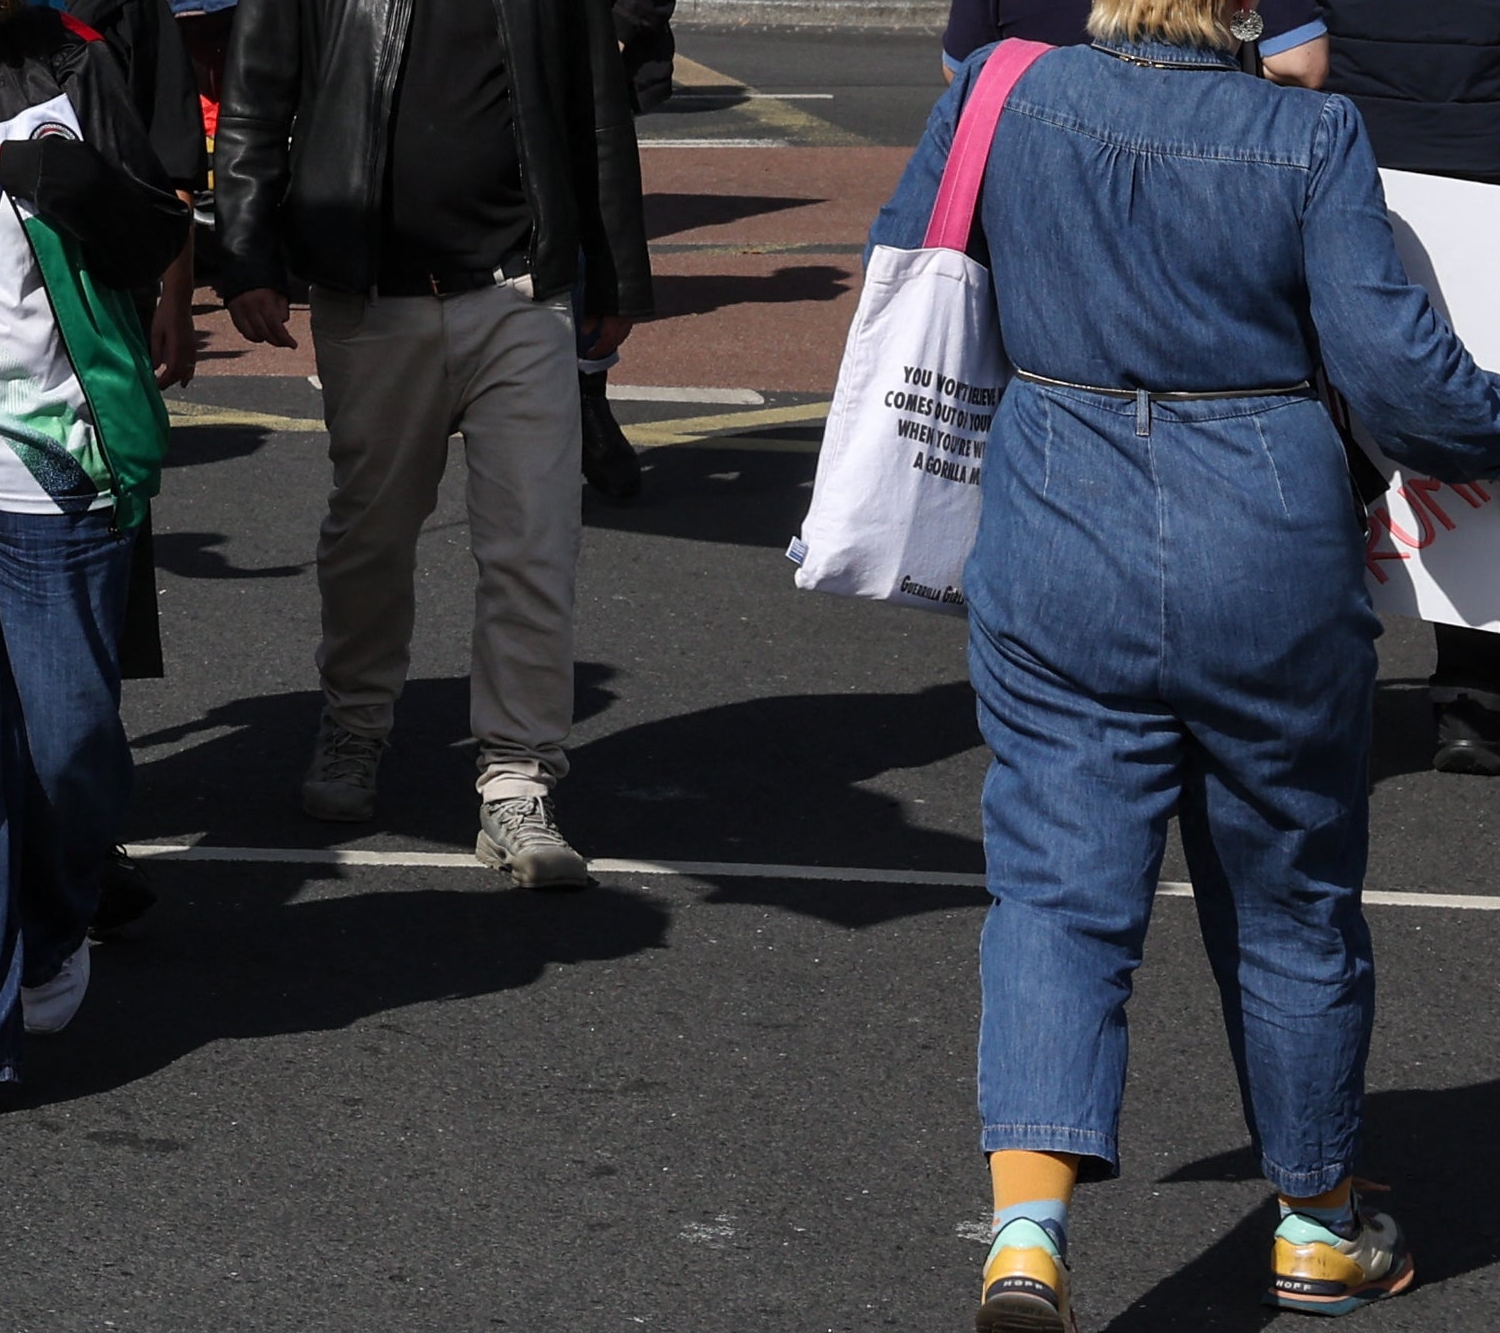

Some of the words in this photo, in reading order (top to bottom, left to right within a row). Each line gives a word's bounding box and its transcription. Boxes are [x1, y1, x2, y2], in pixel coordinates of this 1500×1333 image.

[903, 365, 933, 388] YOU
[884, 390, 933, 417] COMES
[934, 401, 956, 424] OUT
[897, 418, 935, 444] WHEN
[913, 451, 924, 470] A
[925, 455, 967, 485] GORILLA
